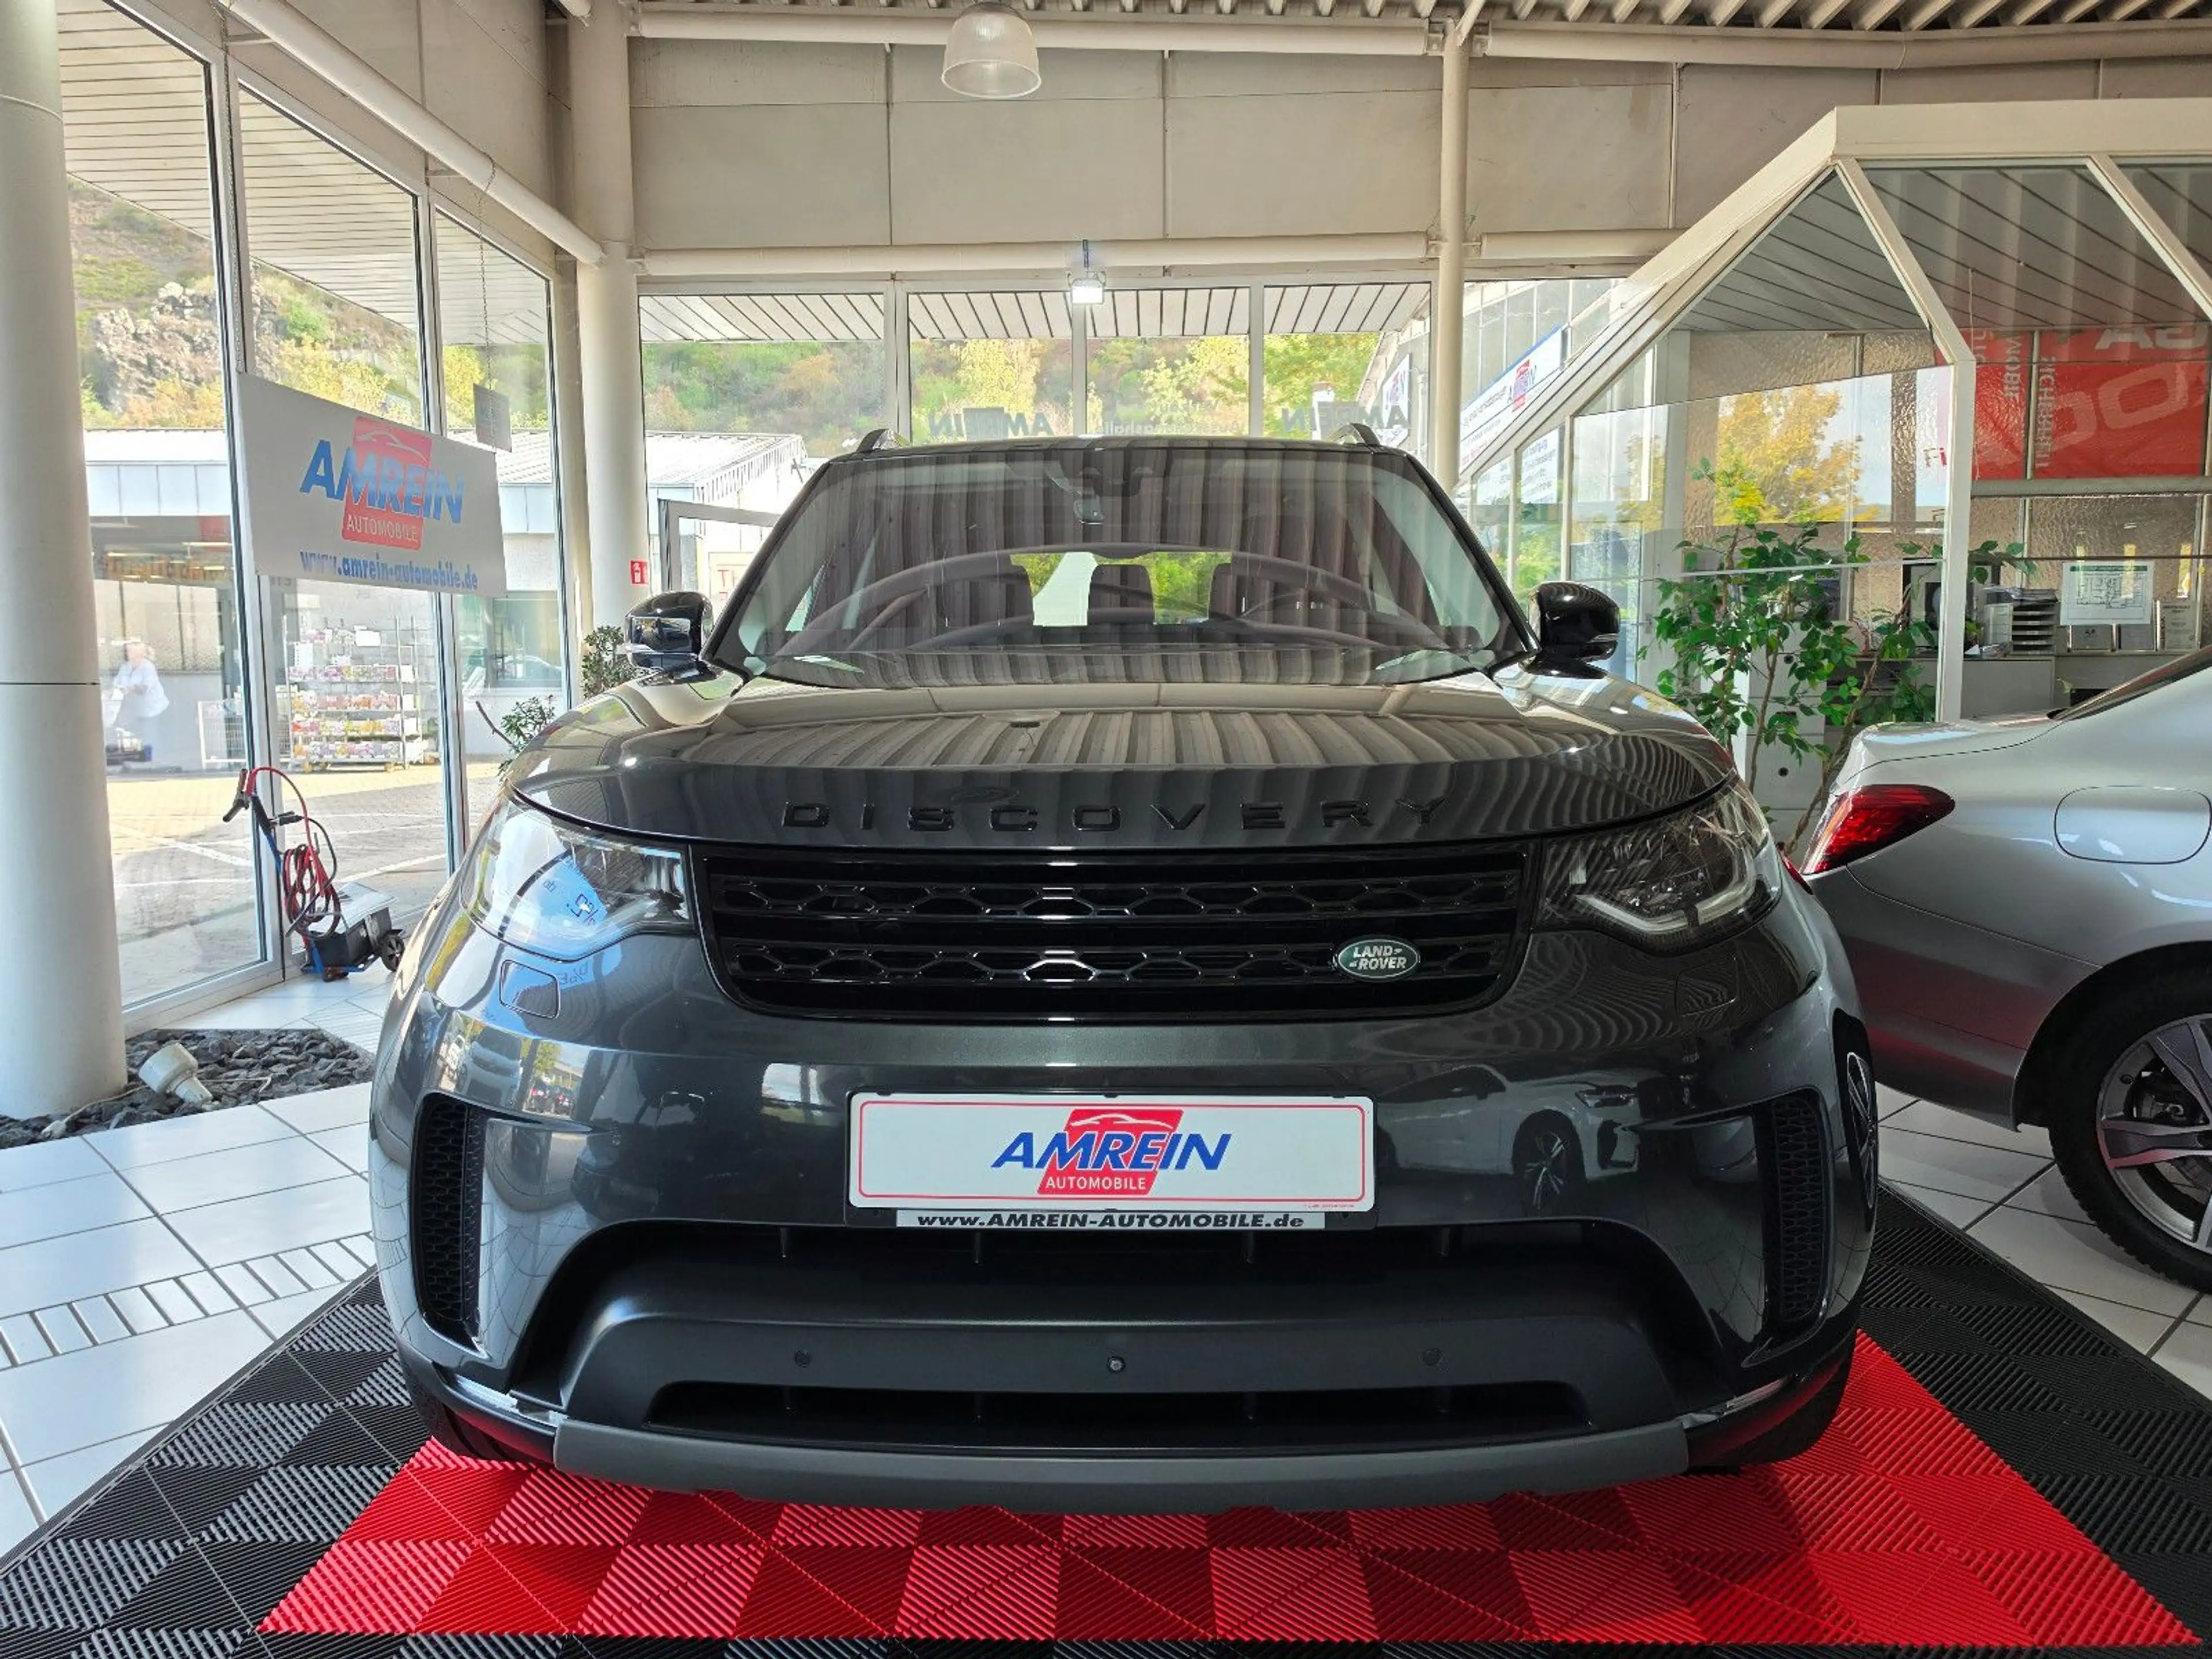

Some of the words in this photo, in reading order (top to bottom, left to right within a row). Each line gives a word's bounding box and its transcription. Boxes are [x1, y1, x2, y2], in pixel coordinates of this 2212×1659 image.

[300, 440, 465, 524] AMREIN
[347, 514, 419, 543] AUTOMOBILE
[780, 797, 1448, 832] DISCOVERY
[991, 1131, 1233, 1171] AMREIN
[1046, 1176, 1146, 1190] AUTOMOBILE
[917, 1213, 1305, 1228] www.AMREIN-AUTOMOBILE.de
